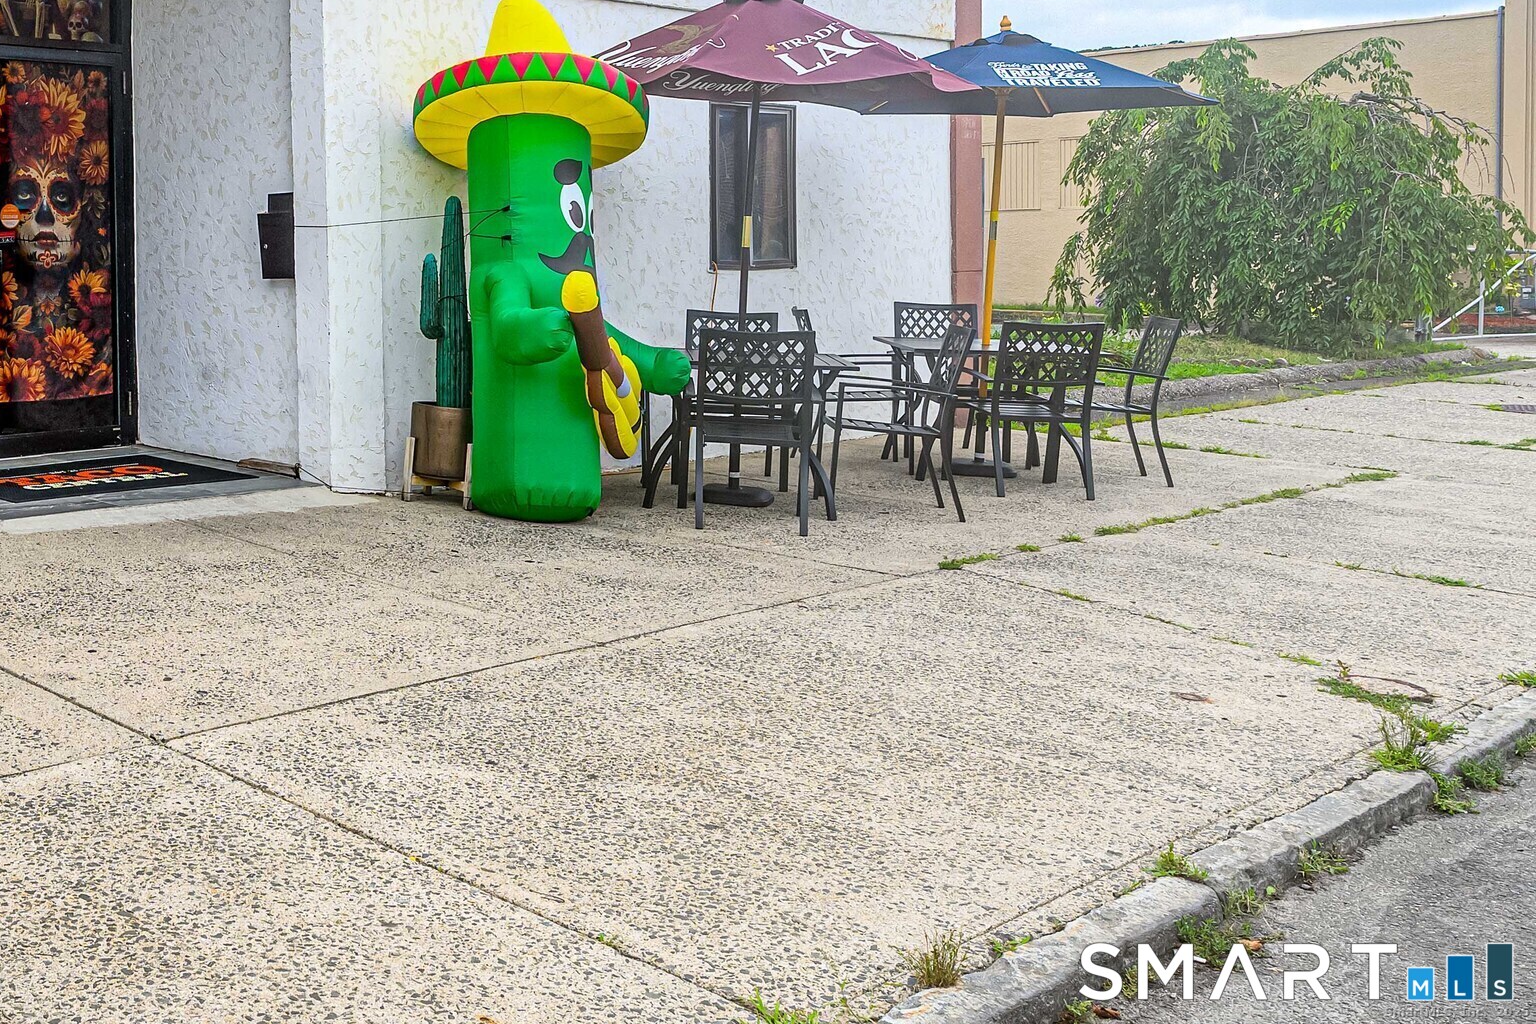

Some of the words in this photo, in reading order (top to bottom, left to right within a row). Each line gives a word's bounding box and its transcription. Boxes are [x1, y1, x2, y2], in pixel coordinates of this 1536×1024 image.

[1030, 62, 1088, 72] TAKING
[1009, 68, 1052, 78] ROAD
[1003, 78, 1101, 87] TRAVELED
